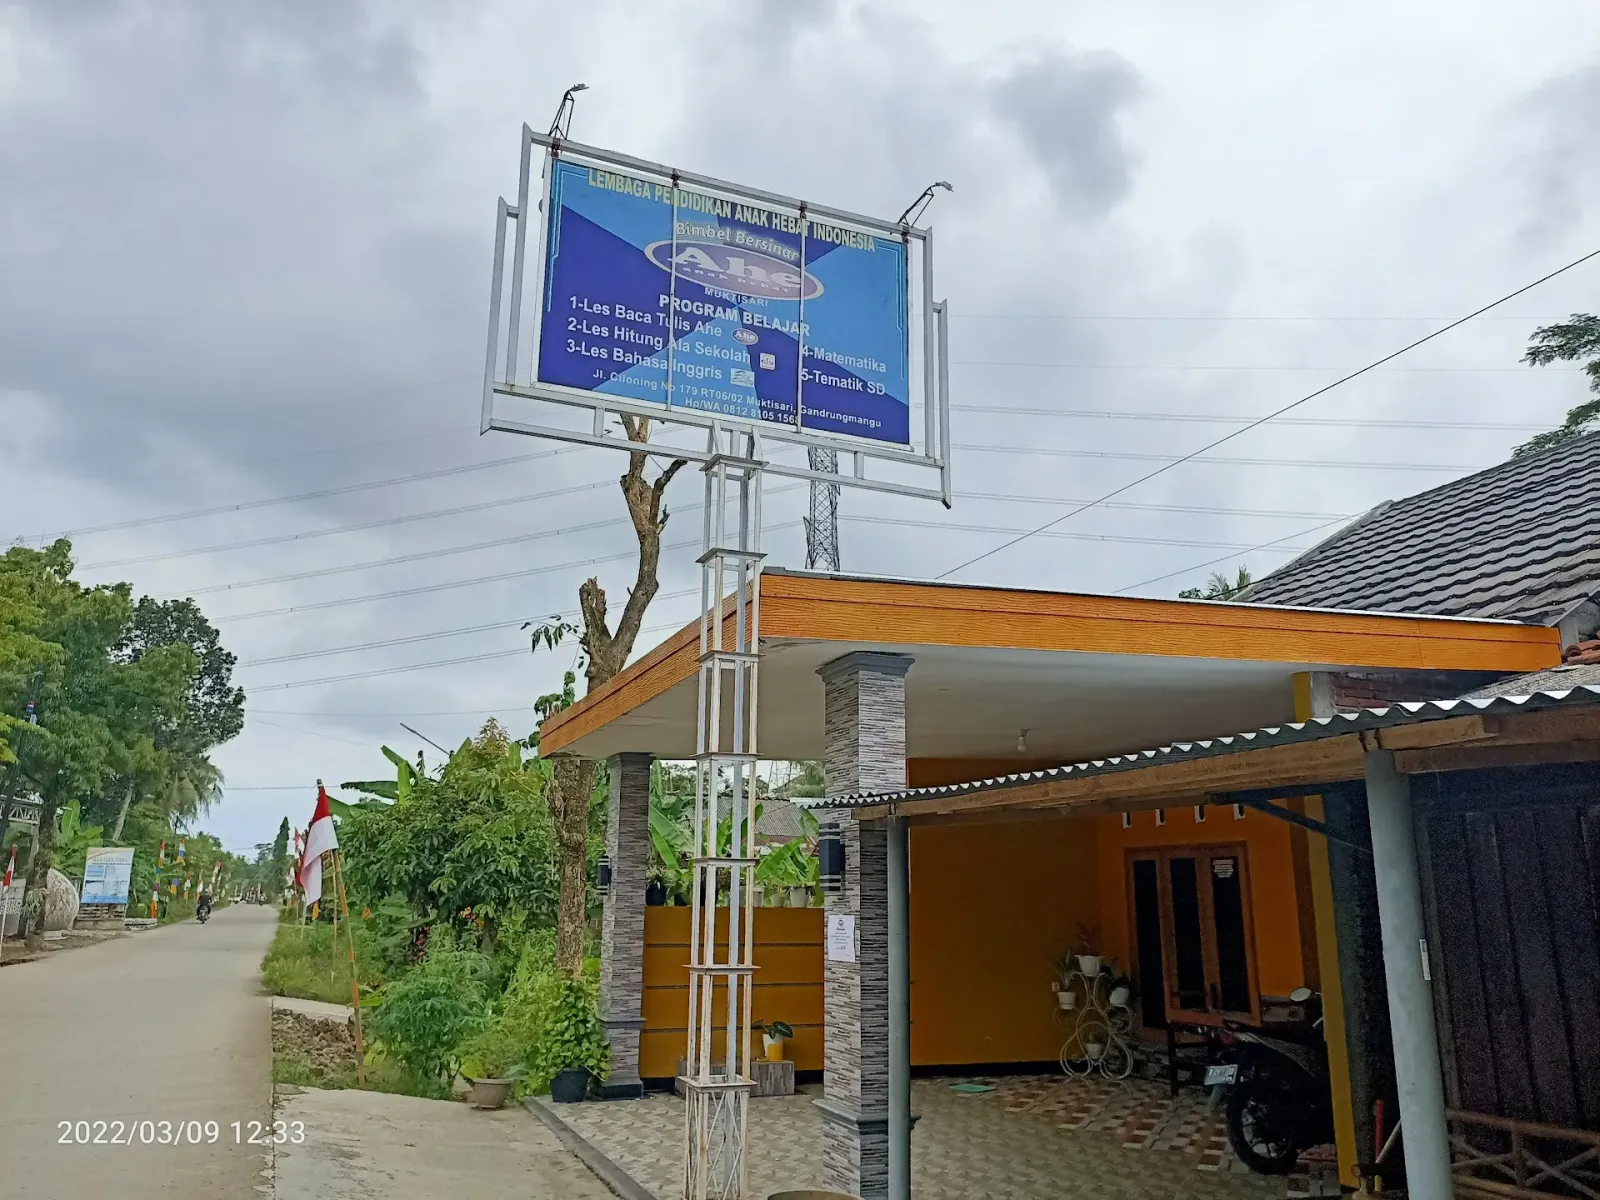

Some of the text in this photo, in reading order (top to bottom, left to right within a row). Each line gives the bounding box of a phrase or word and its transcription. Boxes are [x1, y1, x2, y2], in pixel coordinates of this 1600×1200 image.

[588, 168, 651, 199] LEMBAGA
[735, 204, 769, 228] ANAK
[772, 213, 810, 237] HEBAT
[813, 223, 876, 253] INDONESIA
[676, 221, 800, 261] Bimbel Bersinar
[667, 247, 801, 289] Ahe
[569, 295, 722, 337] 1-Les Baca Tulis Ahe
[659, 294, 810, 337] PROGRAM BELAJAR
[704, 286, 768, 307] MUKTISARI
[566, 338, 608, 359] 3-Les
[613, 347, 668, 370] Bahasa
[672, 358, 722, 380] Inggris
[567, 317, 609, 337] 2-Les
[614, 326, 663, 351] Hitung
[667, 336, 690, 352] Ala
[695, 341, 751, 364] Sekolah
[802, 344, 886, 373] 4-Matematika
[592, 368, 607, 380] Jl.
[610, 372, 658, 391] Ciloning
[680, 384, 698, 397] 179
[701, 388, 743, 403] RT06/02
[746, 395, 797, 413] Muktisari,
[801, 405, 882, 428] Gandrungmangu
[801, 367, 886, 396] 5-Tematik SD
[685, 397, 721, 412] Hp/WA
[723, 403, 748, 416] 0812
[750, 408, 775, 421] 8105
